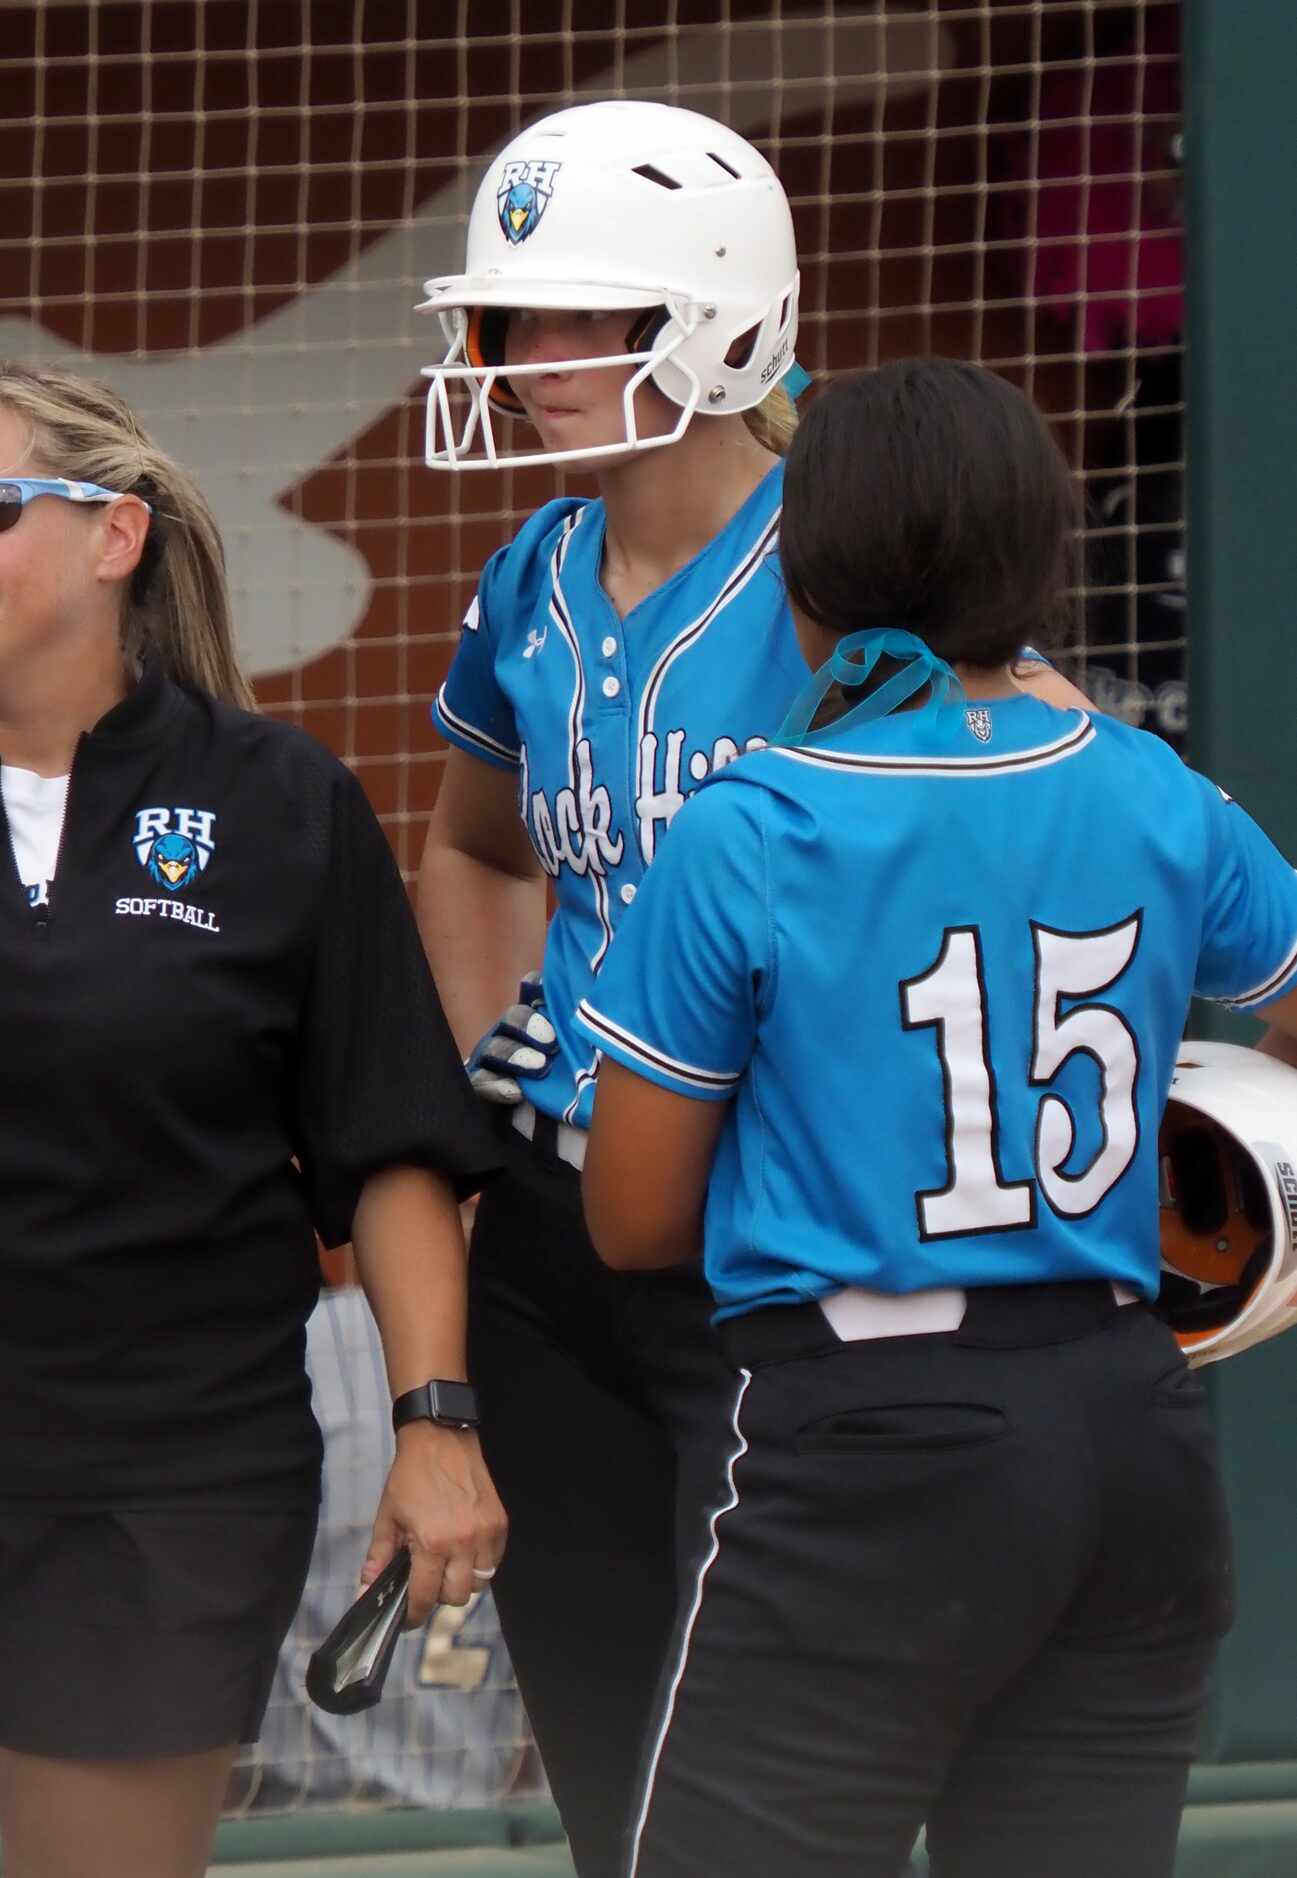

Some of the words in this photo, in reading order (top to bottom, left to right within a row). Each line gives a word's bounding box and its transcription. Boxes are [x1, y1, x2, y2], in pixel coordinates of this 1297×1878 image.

[497, 160, 562, 198] RH
[132, 806, 216, 850] RH
[115, 898, 220, 933] SOFTBALL
[899, 907, 1144, 1243] 15
